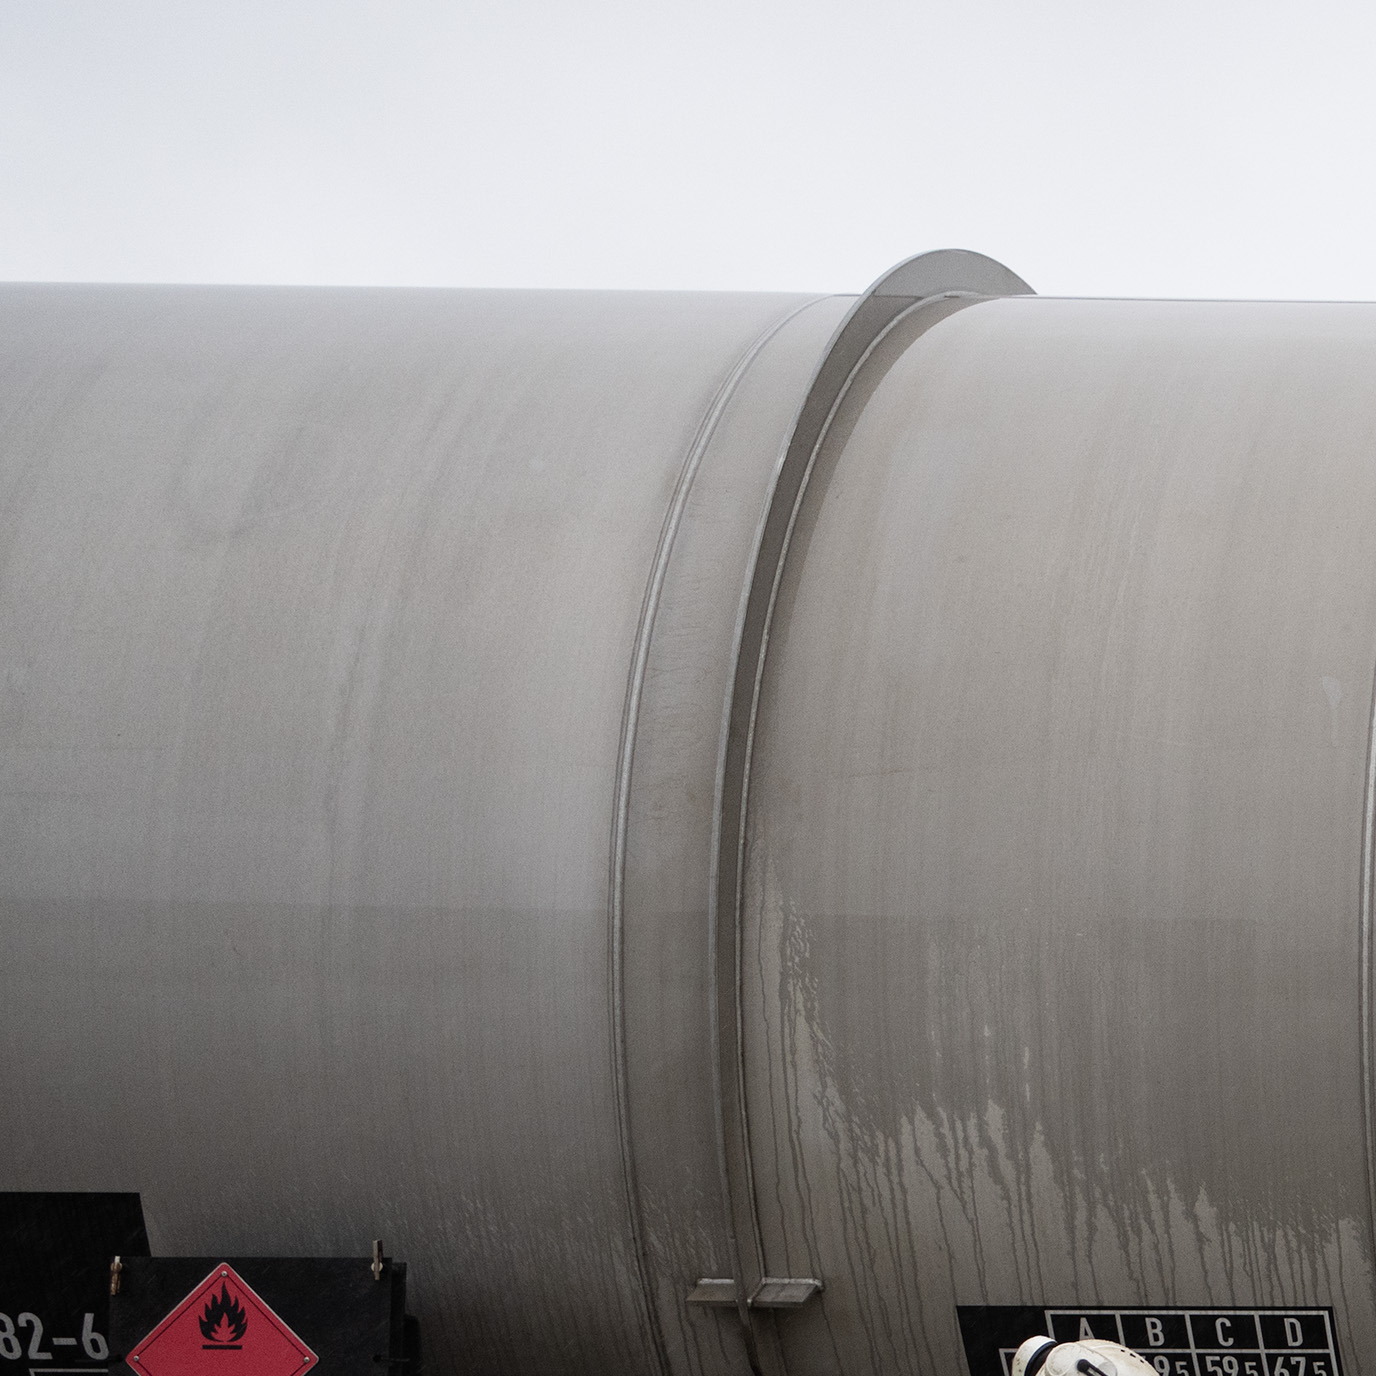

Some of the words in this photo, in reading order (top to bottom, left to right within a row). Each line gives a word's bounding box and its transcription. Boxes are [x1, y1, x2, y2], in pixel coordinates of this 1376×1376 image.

[1079, 1317, 1096, 1340] A
[1145, 1317, 1165, 1347] B
[1214, 1317, 1235, 1348] C
[1283, 1317, 1304, 1348] D
